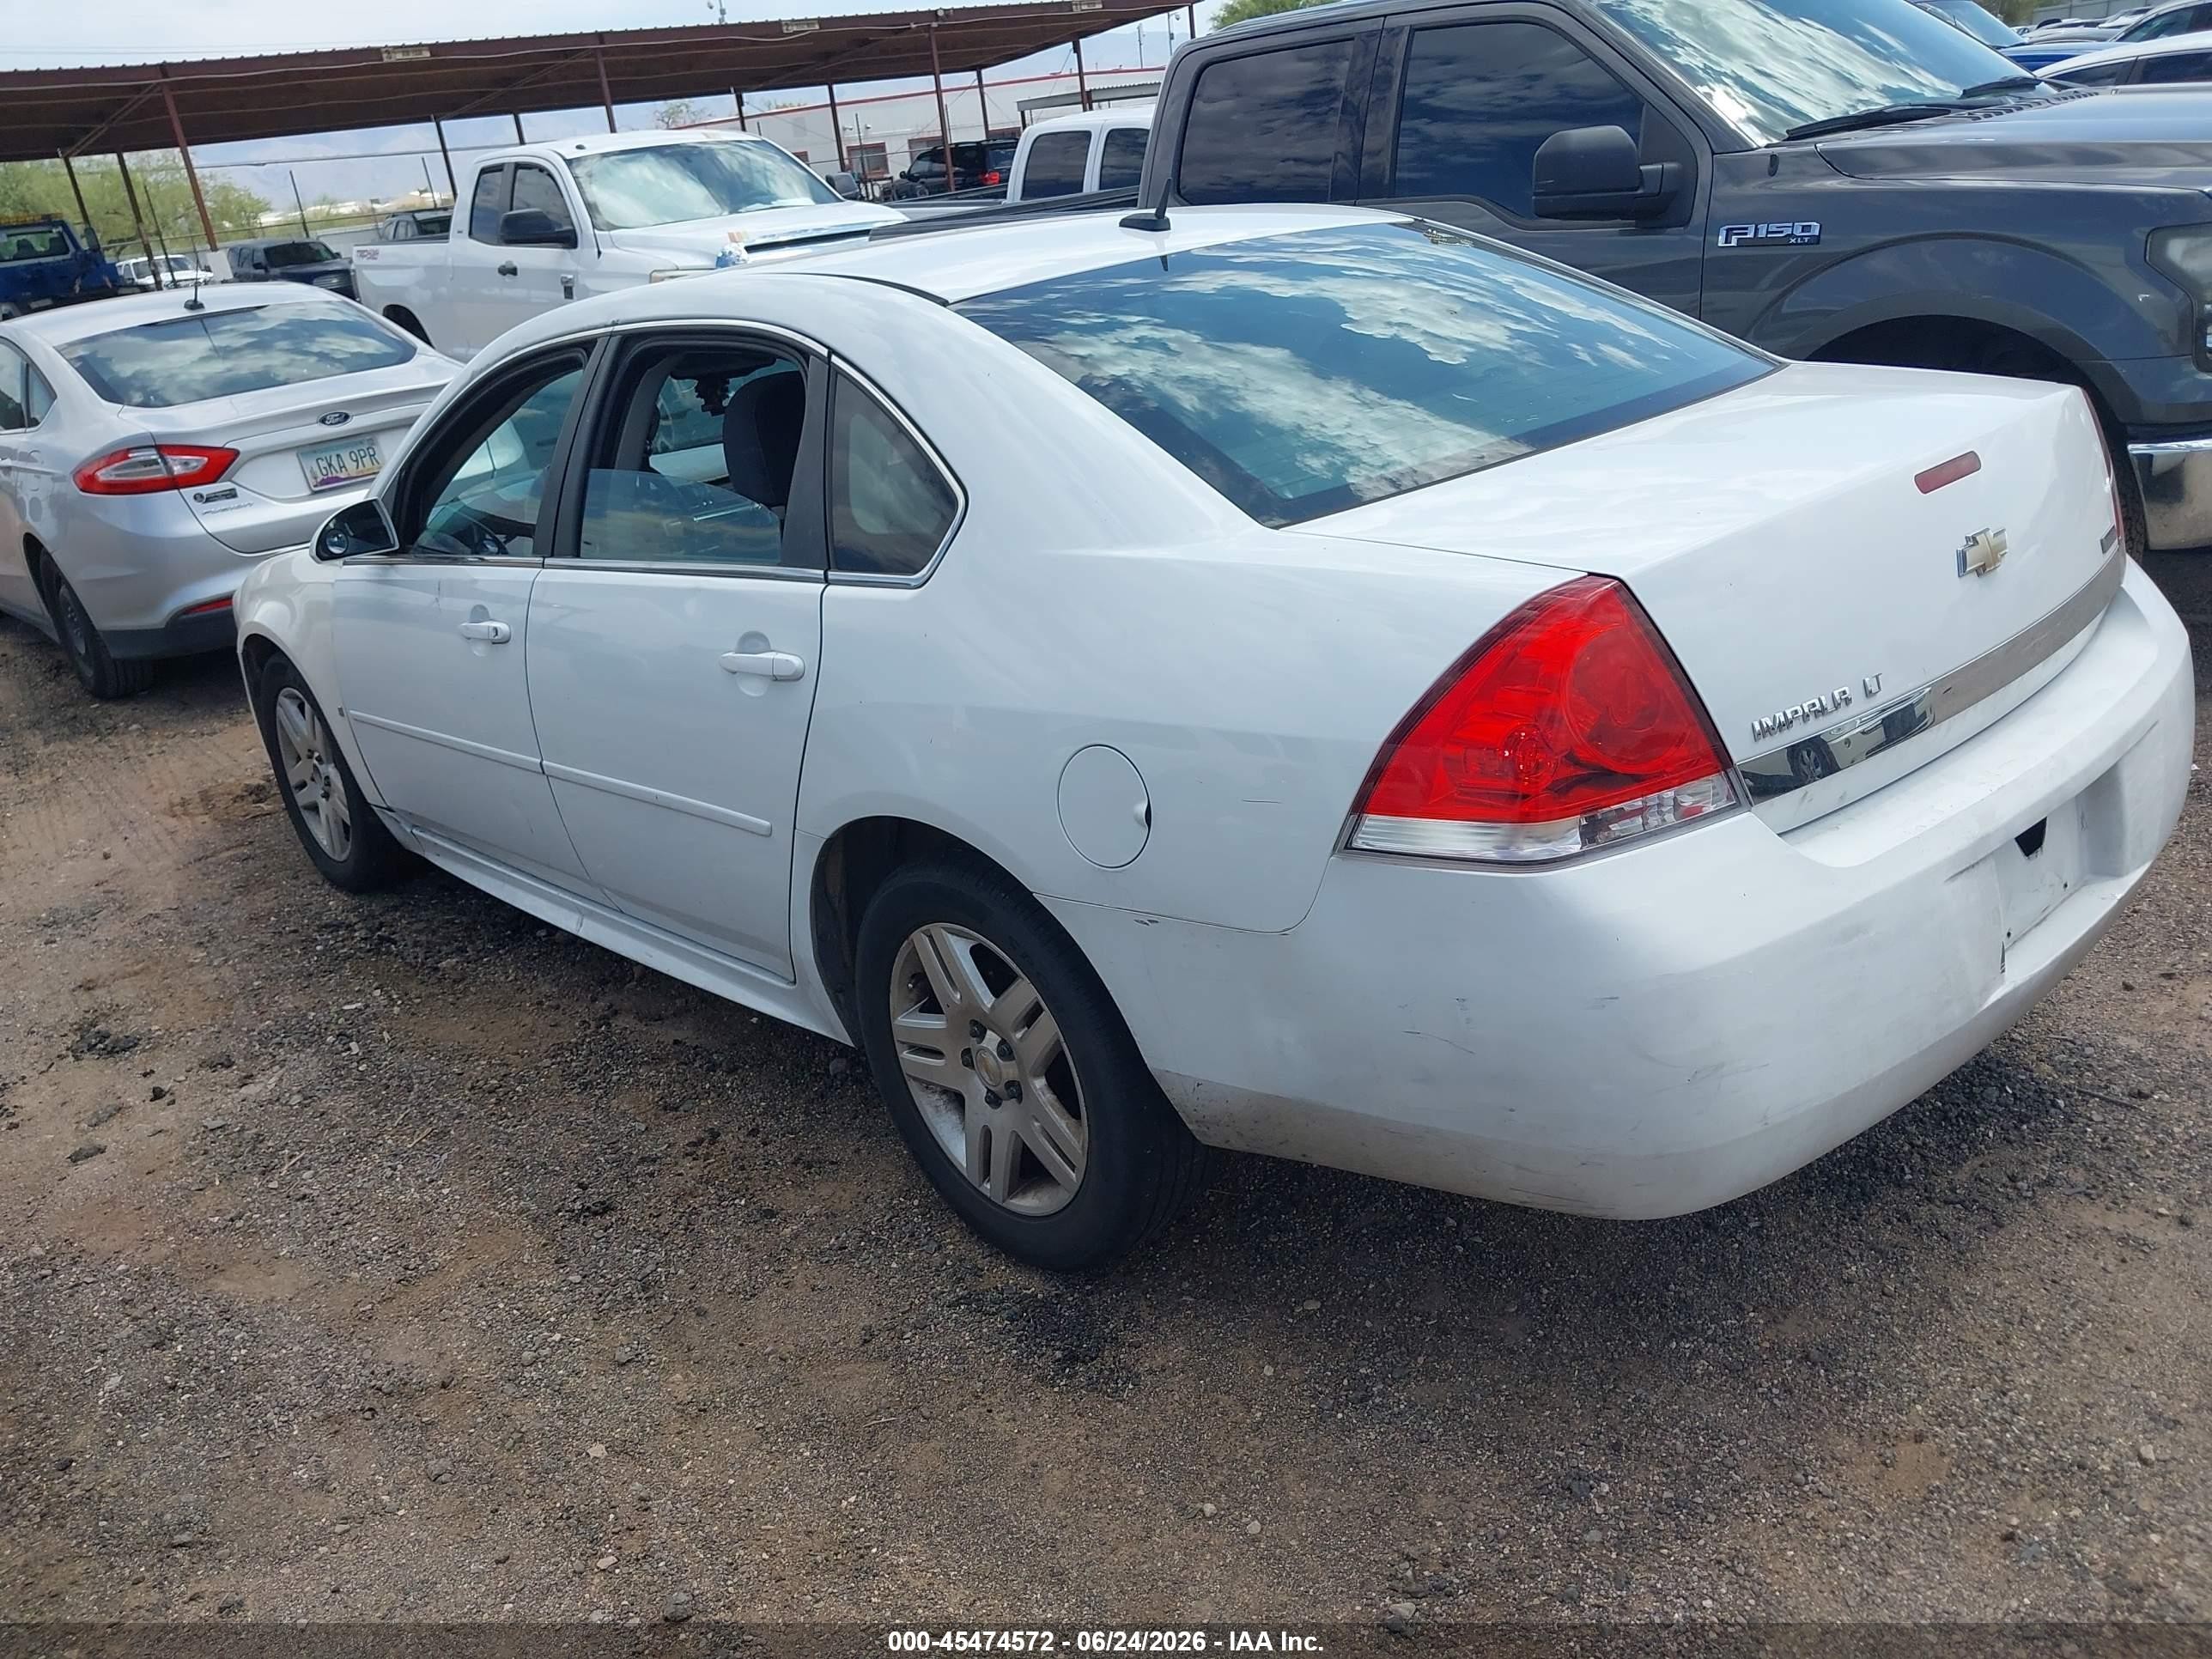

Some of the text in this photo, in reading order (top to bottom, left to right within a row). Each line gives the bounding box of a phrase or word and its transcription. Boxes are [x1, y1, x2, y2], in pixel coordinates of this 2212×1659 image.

[1717, 222, 1820, 246] F150
[315, 447, 380, 477] GKA 9PR
[1752, 672, 1883, 742] IMPALA LT
